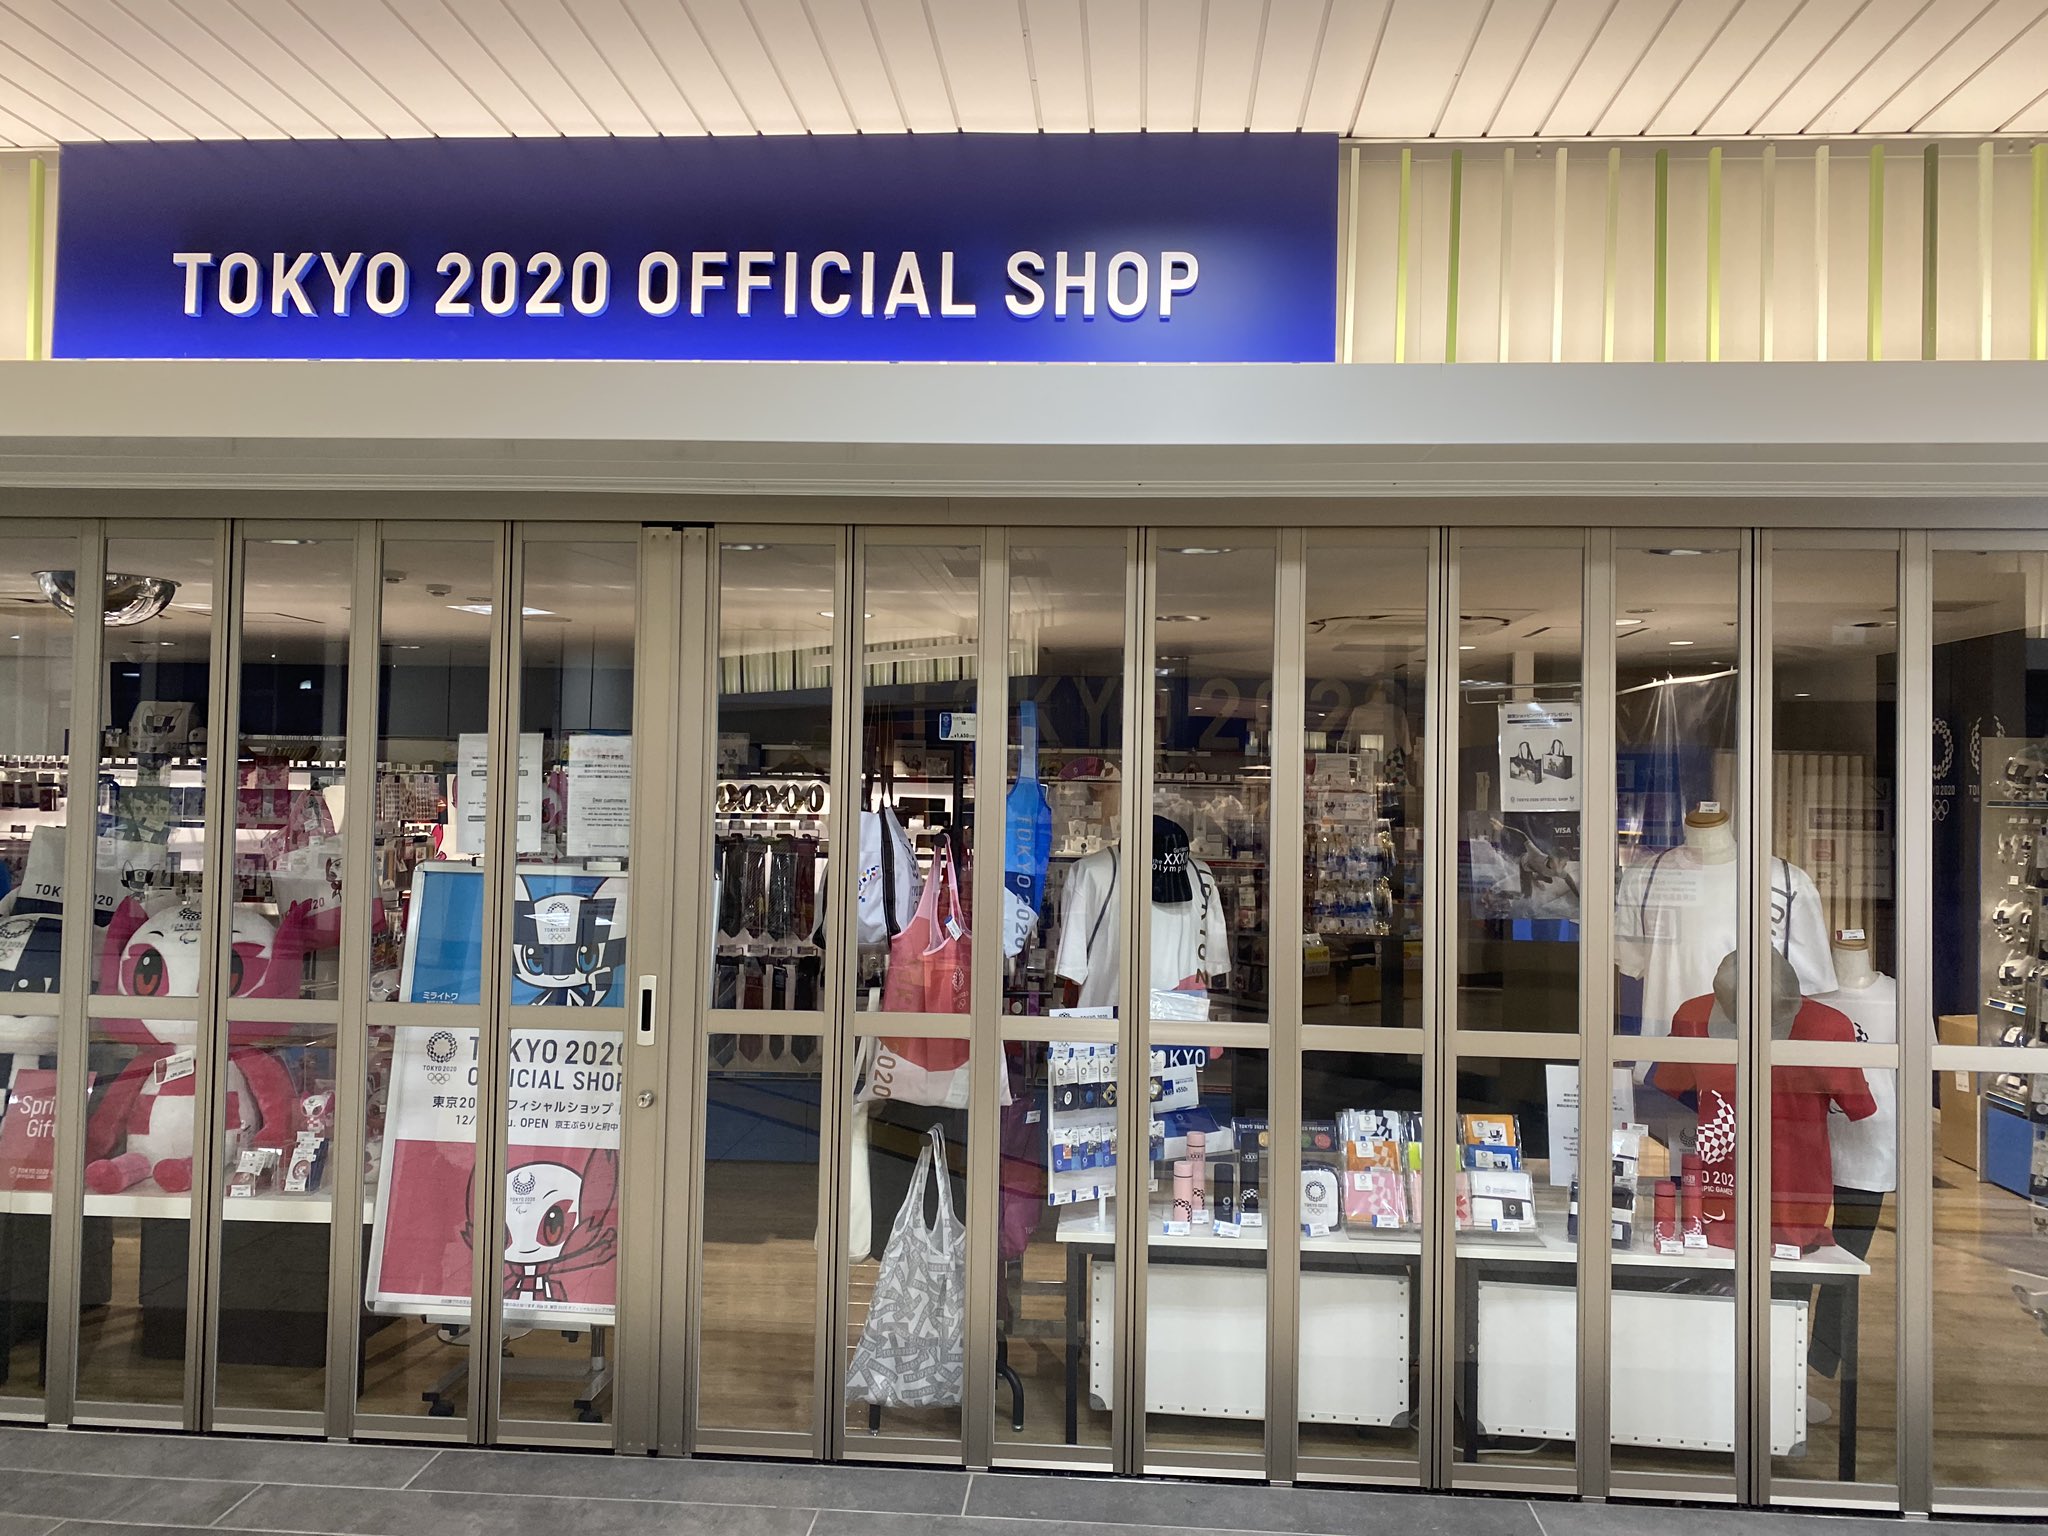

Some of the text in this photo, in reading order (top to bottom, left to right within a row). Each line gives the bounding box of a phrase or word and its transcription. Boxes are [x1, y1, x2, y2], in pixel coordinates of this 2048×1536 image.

[173, 250, 1200, 320] TOKYO 2020 OFFICIAL SHOP
[1014, 816, 1033, 949] TOKYO 2020
[422, 991, 459, 1001] ミライトワ
[422, 1064, 442, 1072] TOKYO
[520, 1117, 549, 1129] OPEN
[1713, 1171, 1734, 1188] 202
